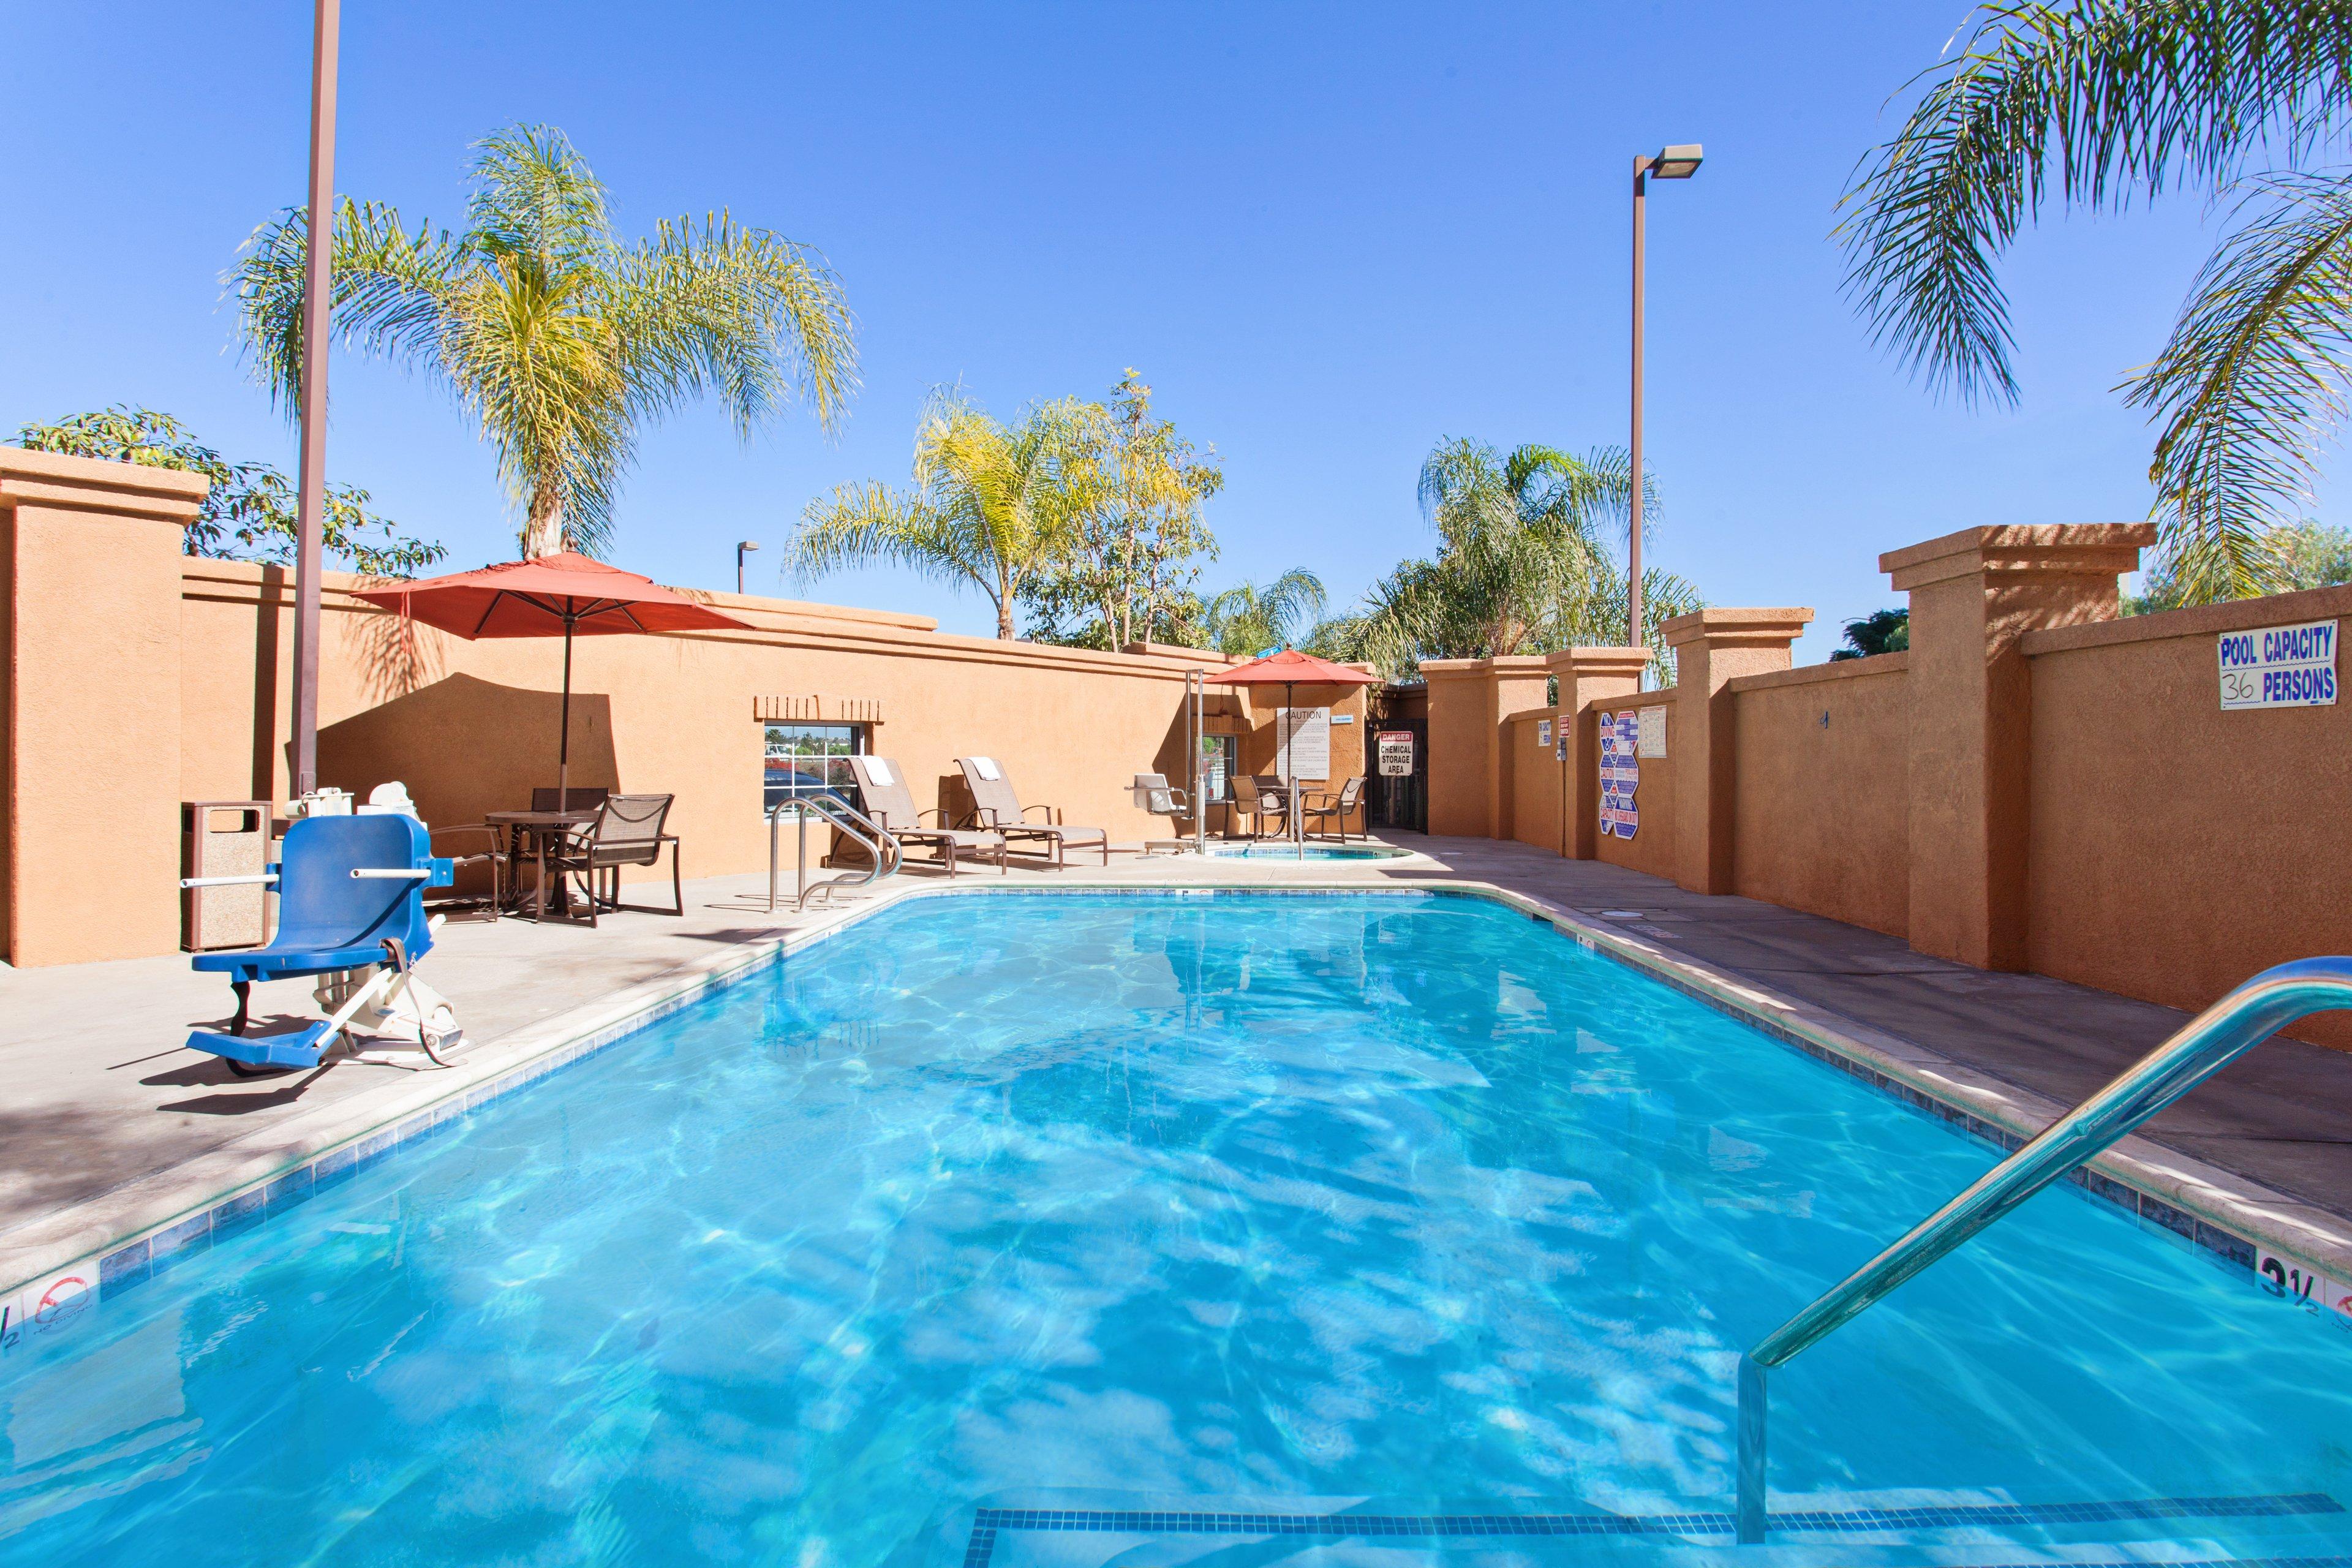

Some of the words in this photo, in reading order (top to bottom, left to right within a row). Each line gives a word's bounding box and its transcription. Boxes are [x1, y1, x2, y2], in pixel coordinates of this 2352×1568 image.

[2221, 635, 2257, 666] POOL
[2264, 625, 2332, 663] CAPACITY
[2222, 672, 2253, 700] 36
[2263, 667, 2334, 702] PERSONS
[1604, 714, 1611, 726] NO
[1600, 726, 1615, 737] DIVING
[1381, 745, 1412, 754] CHEMICAL
[1382, 755, 1410, 764] STORAGE
[1388, 765, 1404, 774] AREA
